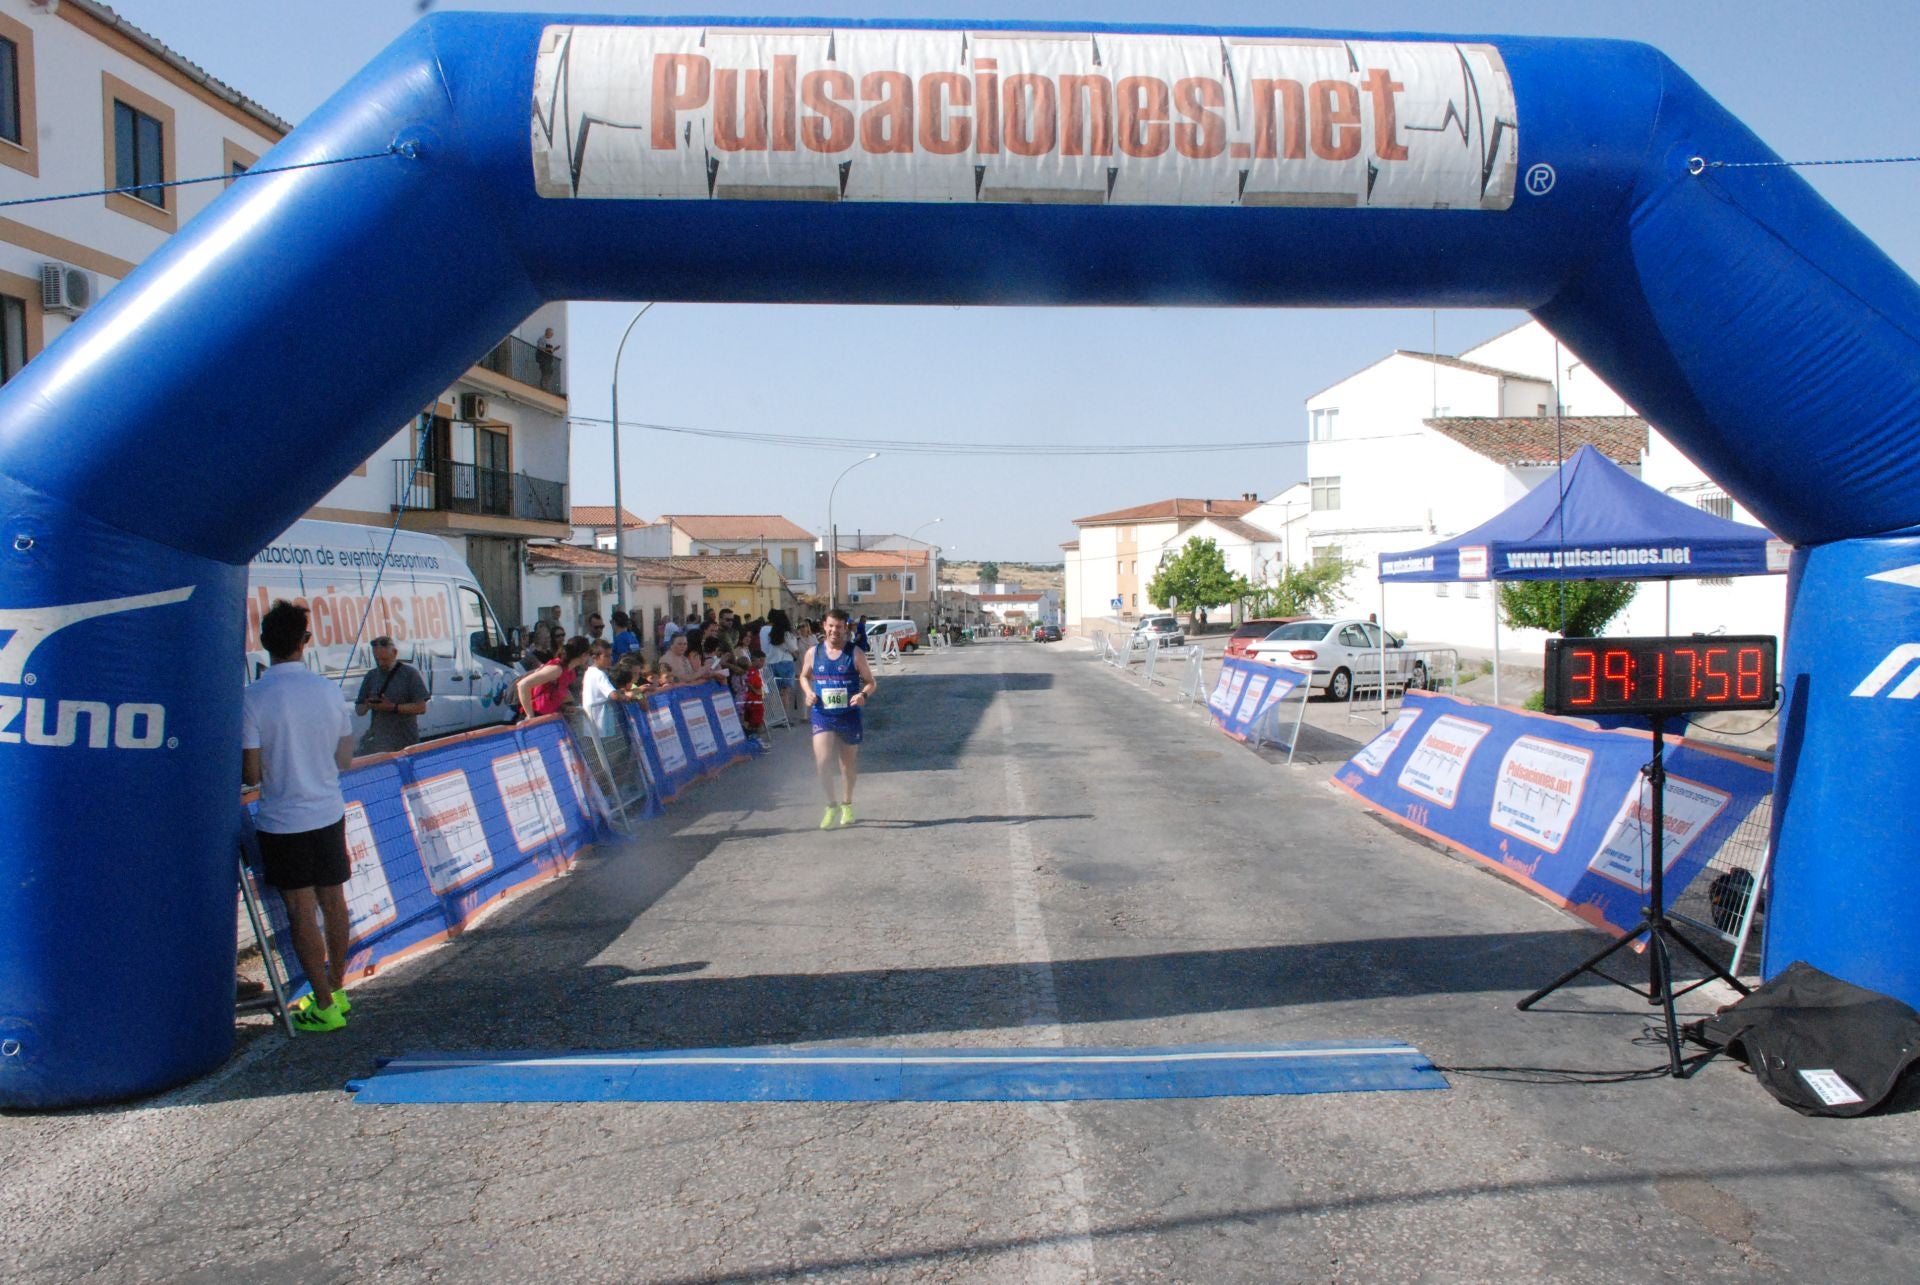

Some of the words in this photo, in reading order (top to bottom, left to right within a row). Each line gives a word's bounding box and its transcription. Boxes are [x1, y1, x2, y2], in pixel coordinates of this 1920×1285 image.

[650, 52, 1409, 161] Pulsaciones.net
[316, 544, 335, 566] de
[339, 547, 384, 568] eventos
[386, 550, 440, 572] deportivos
[1571, 648, 1763, 704] 39:17:58
